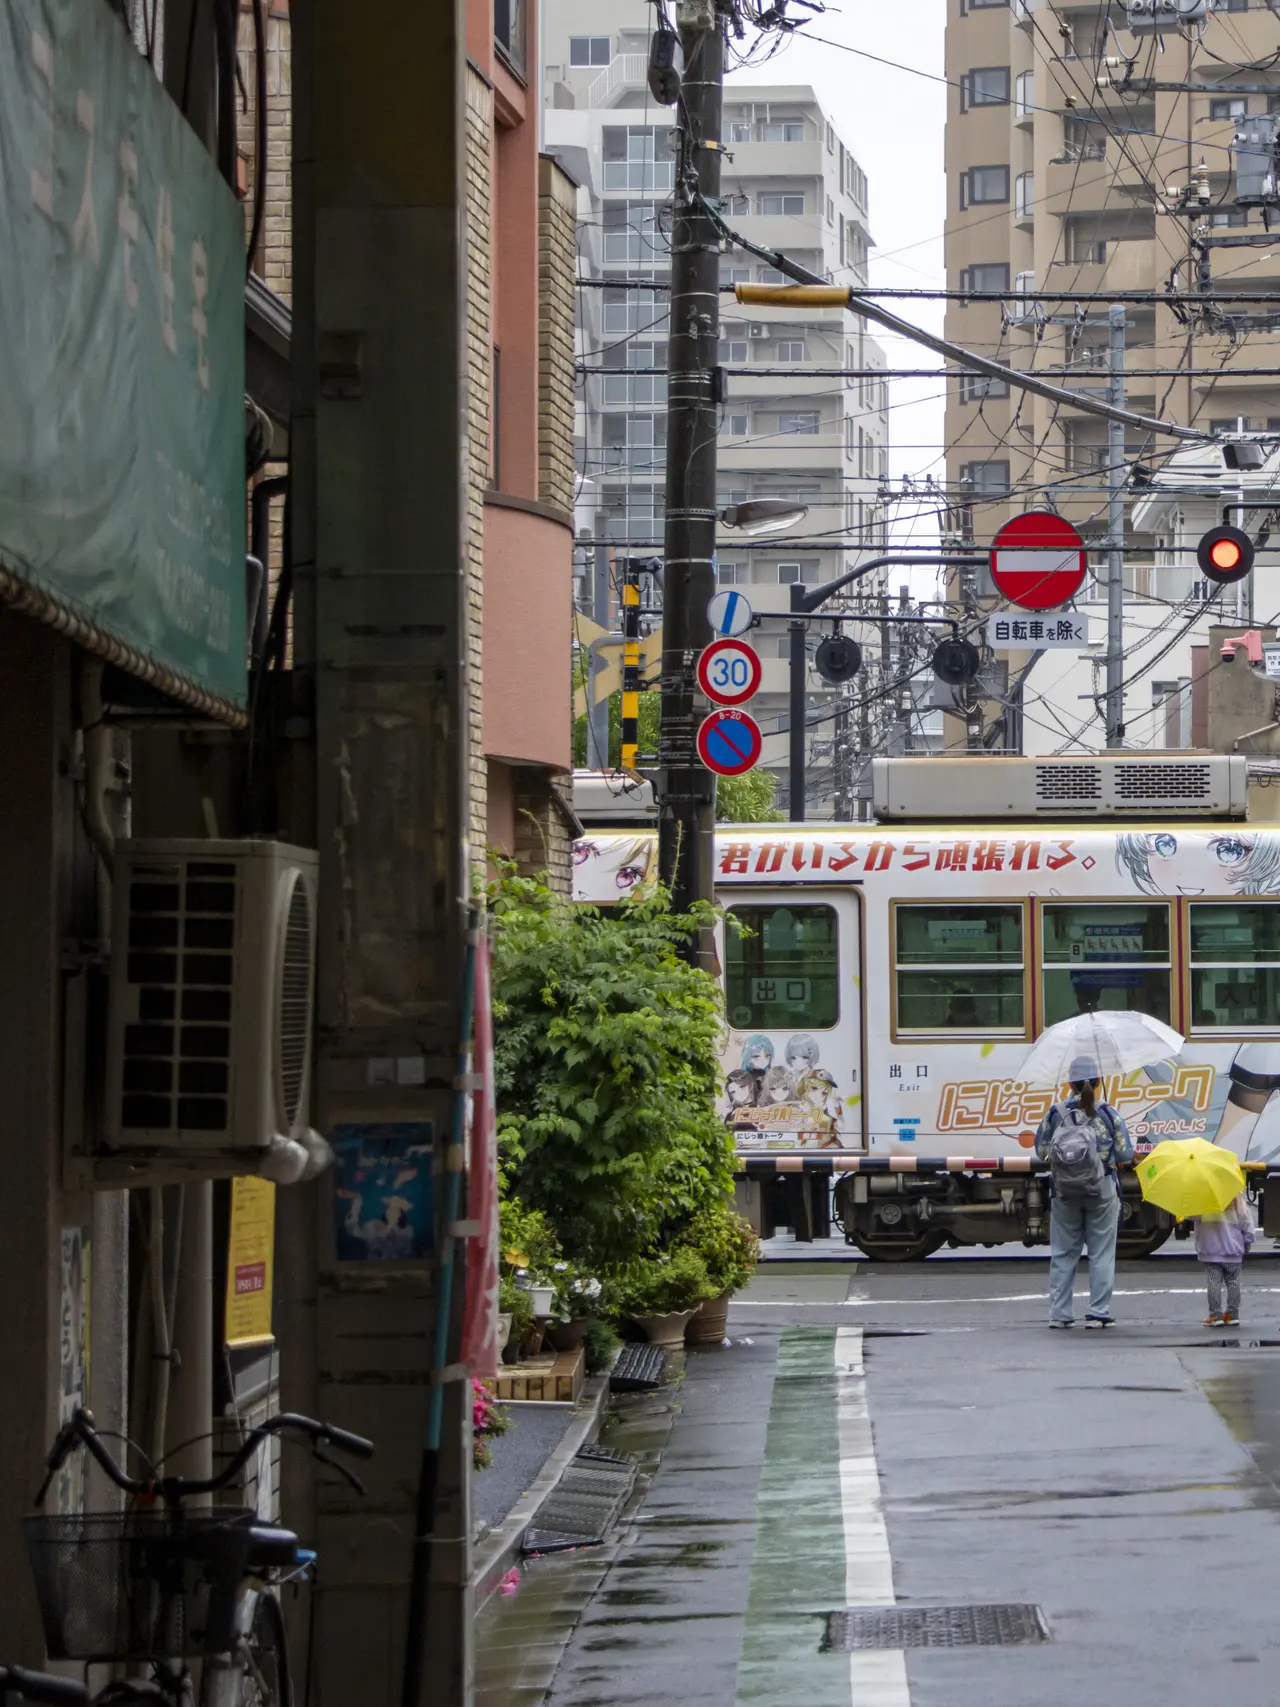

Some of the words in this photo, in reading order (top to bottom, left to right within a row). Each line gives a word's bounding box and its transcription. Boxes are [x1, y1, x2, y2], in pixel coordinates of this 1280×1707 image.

[995, 620, 1083, 641] 自転車を除く
[713, 658, 748, 687] 30
[719, 710, 742, 720] 8-20
[718, 840, 1097, 874] 君がいるから頑張れる。
[756, 979, 806, 1002] 出口
[889, 1064, 928, 1078] 出口
[899, 1083, 920, 1092] Exit
[1151, 1117, 1207, 1135] TALK
